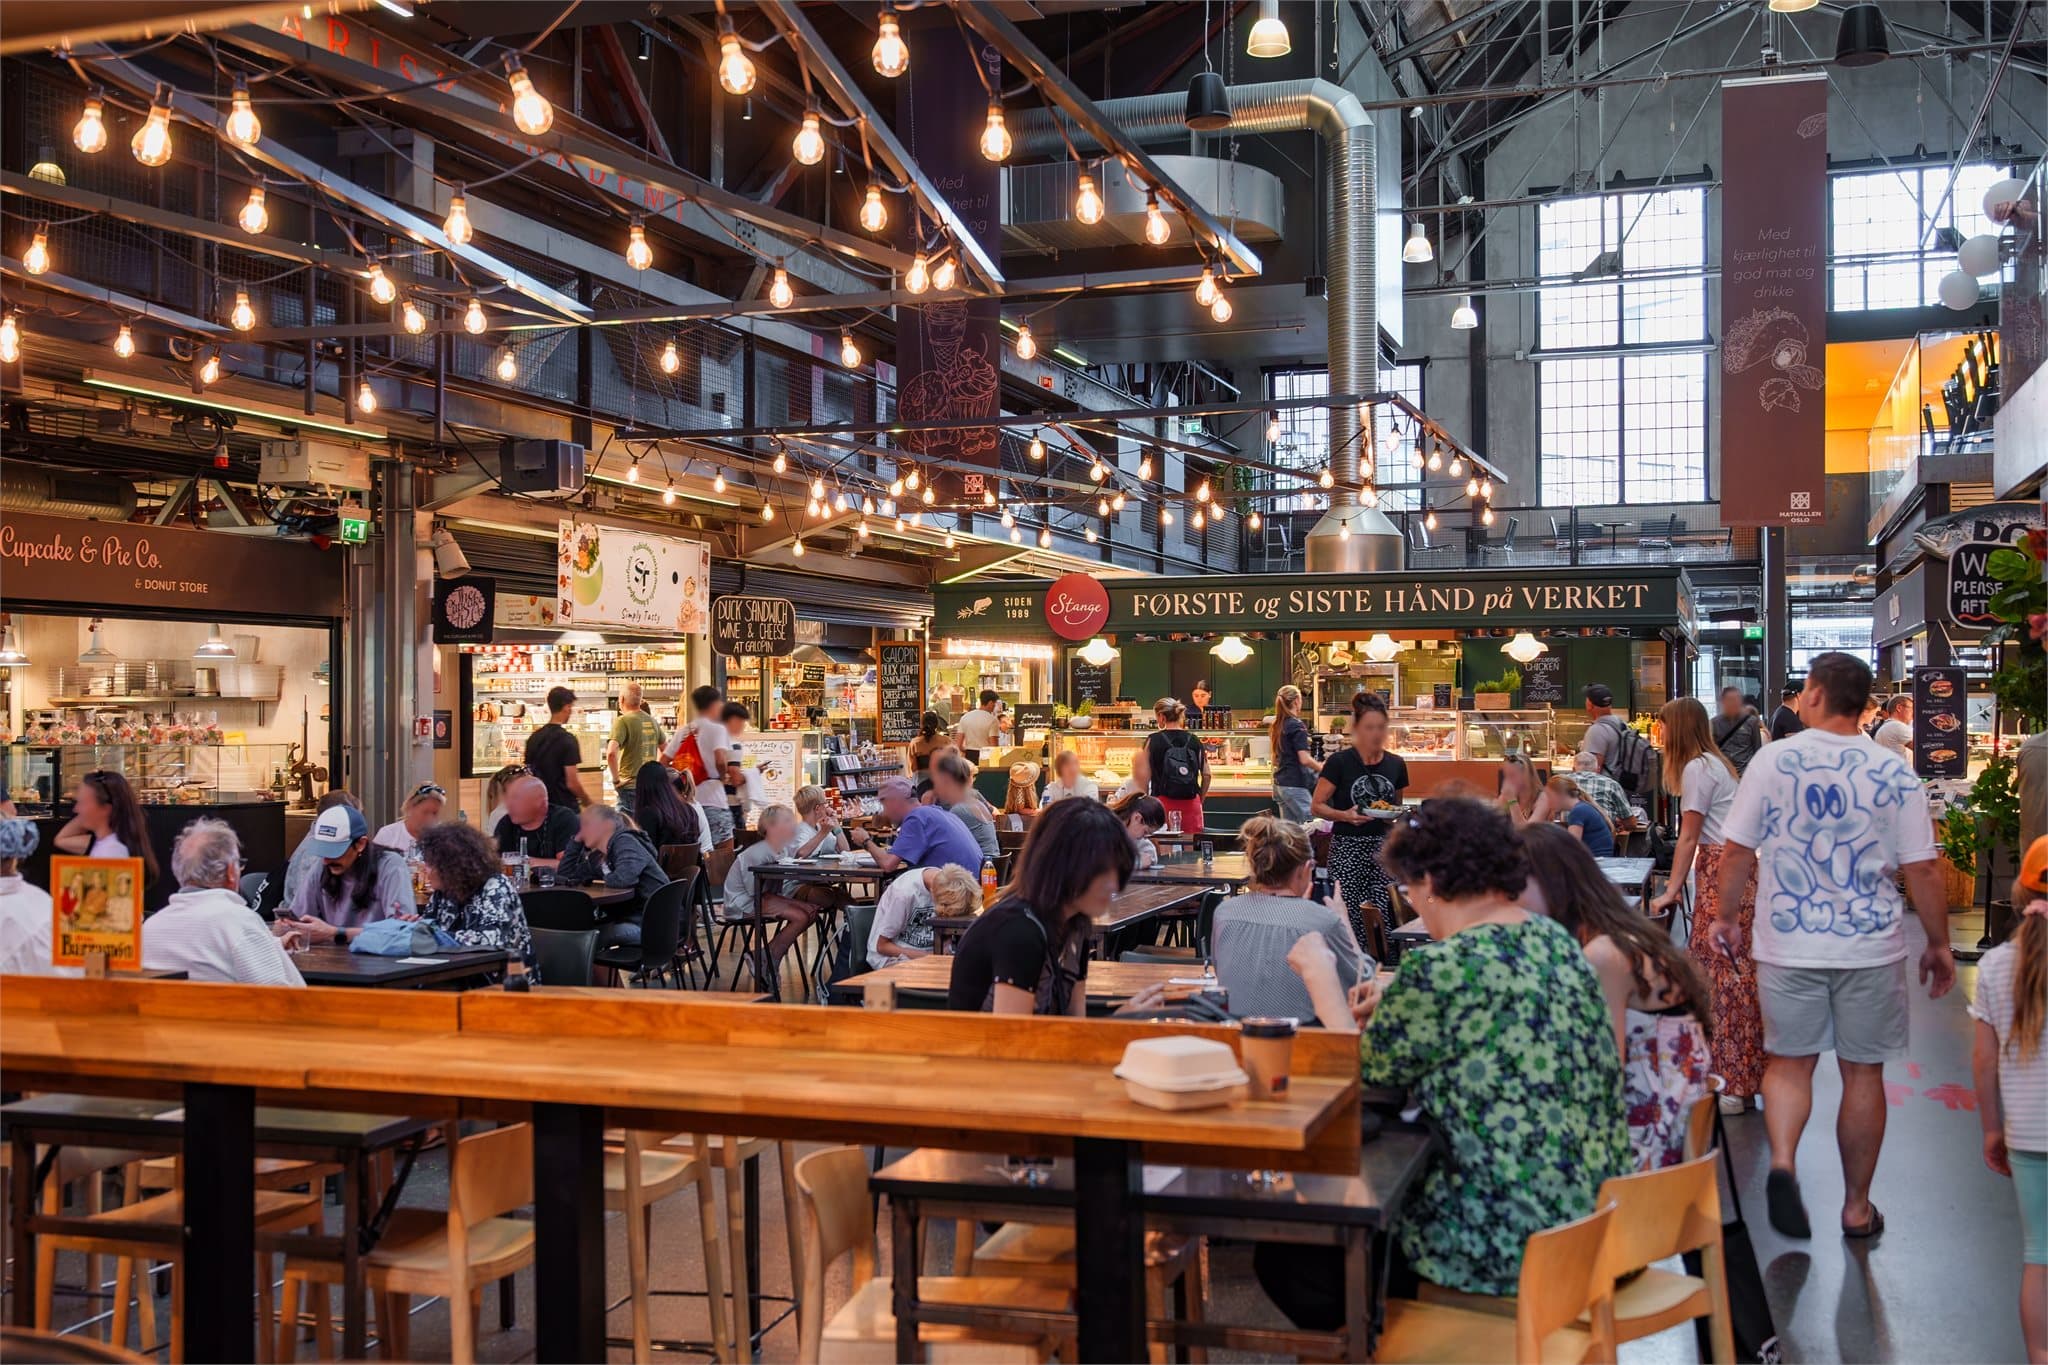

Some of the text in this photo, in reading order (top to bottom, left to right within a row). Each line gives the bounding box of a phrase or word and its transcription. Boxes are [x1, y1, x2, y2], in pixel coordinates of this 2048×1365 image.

[1758, 227, 1791, 240] Med
[1733, 244, 1816, 263] kjærlighet til
[1733, 267, 1815, 284] god mat og
[1754, 285, 1794, 298] drikke
[0, 525, 163, 568] Cupcake & Pie Co.
[135, 579, 208, 593] & DONUT STORE
[1004, 597, 1032, 607] SIDEN
[1051, 592, 1102, 625] Stange
[1133, 583, 1649, 619] FØRSTE og SISTE HÅND på VERKET
[622, 607, 660, 624] Simply Tasty
[718, 600, 788, 624] DUCK SANDWICH
[1007, 609, 1029, 618] 1989
[718, 621, 786, 640] WINE & CHEESE
[733, 640, 774, 653] AT GALOPIN
[882, 647, 918, 663] GALOPIN
[1525, 662, 1560, 672] CHICKEN
